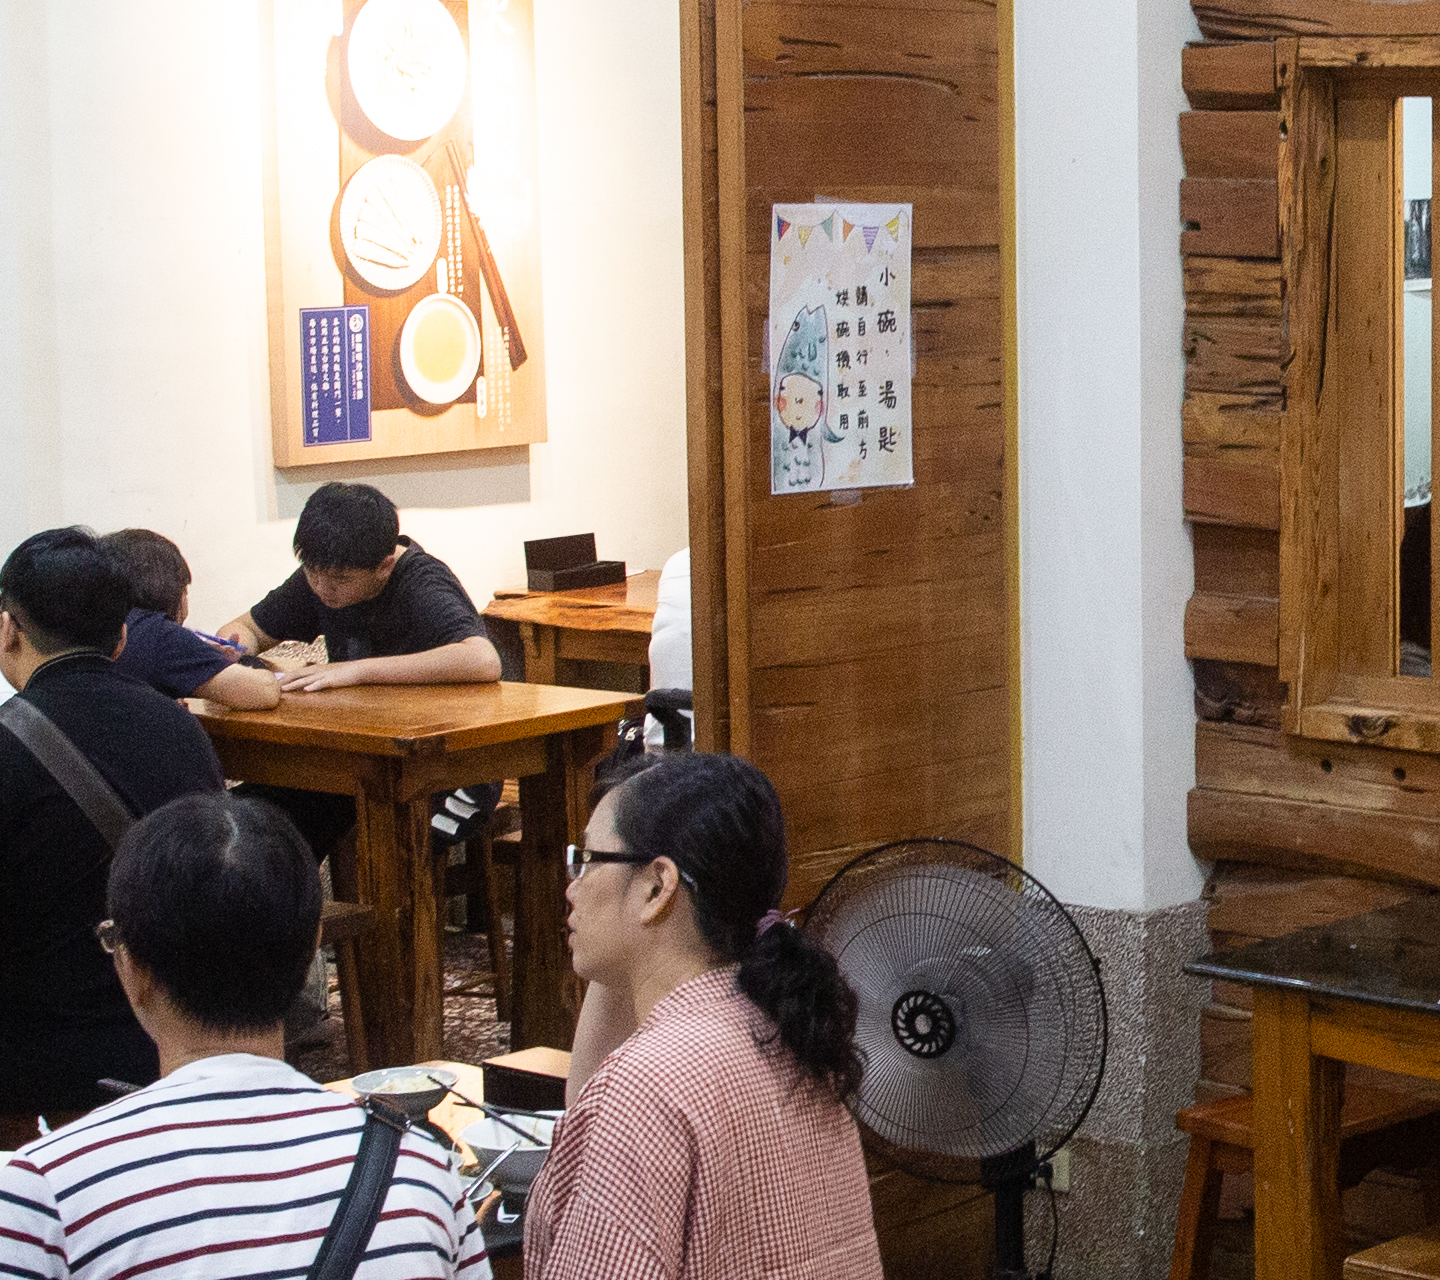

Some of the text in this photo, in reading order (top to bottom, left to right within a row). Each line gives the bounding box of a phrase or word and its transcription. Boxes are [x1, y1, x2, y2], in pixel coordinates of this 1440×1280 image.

[855, 285, 870, 461] 請自行至前方
